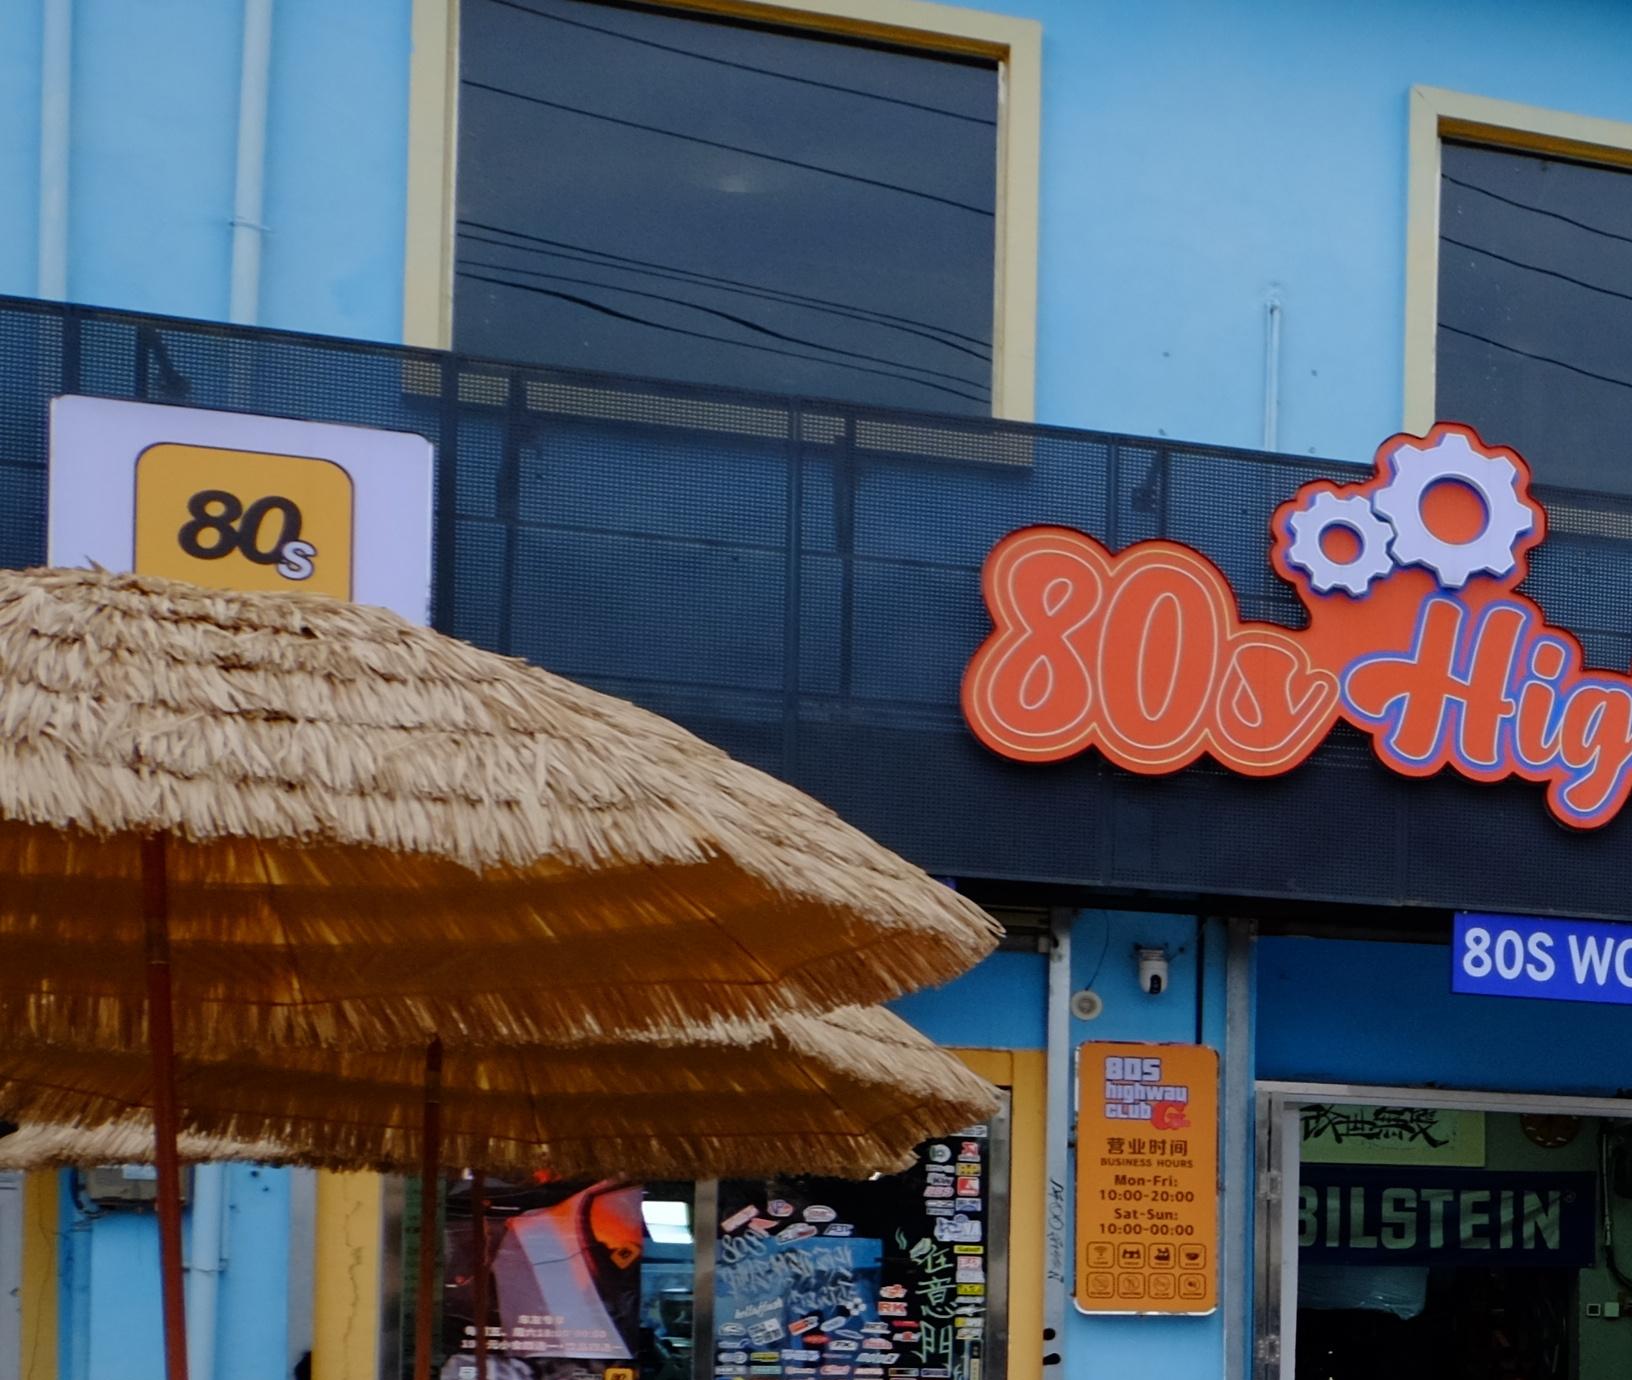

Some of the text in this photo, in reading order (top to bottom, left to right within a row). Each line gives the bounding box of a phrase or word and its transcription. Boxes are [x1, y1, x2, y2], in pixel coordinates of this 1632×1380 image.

[1461, 926, 1556, 983] 80S
[1106, 1137, 1189, 1157] 营业时间
[1100, 1157, 1194, 1168] BUSINESS HOURS
[1114, 1174, 1178, 1188] Mon-Fri:
[1099, 1190, 1195, 1203] 10:00-20:00
[1113, 1208, 1179, 1221] Sat-Sun:
[1298, 1184, 1562, 1250] BILSTEIN
[1099, 1223, 1195, 1236] 10:00-00:00
